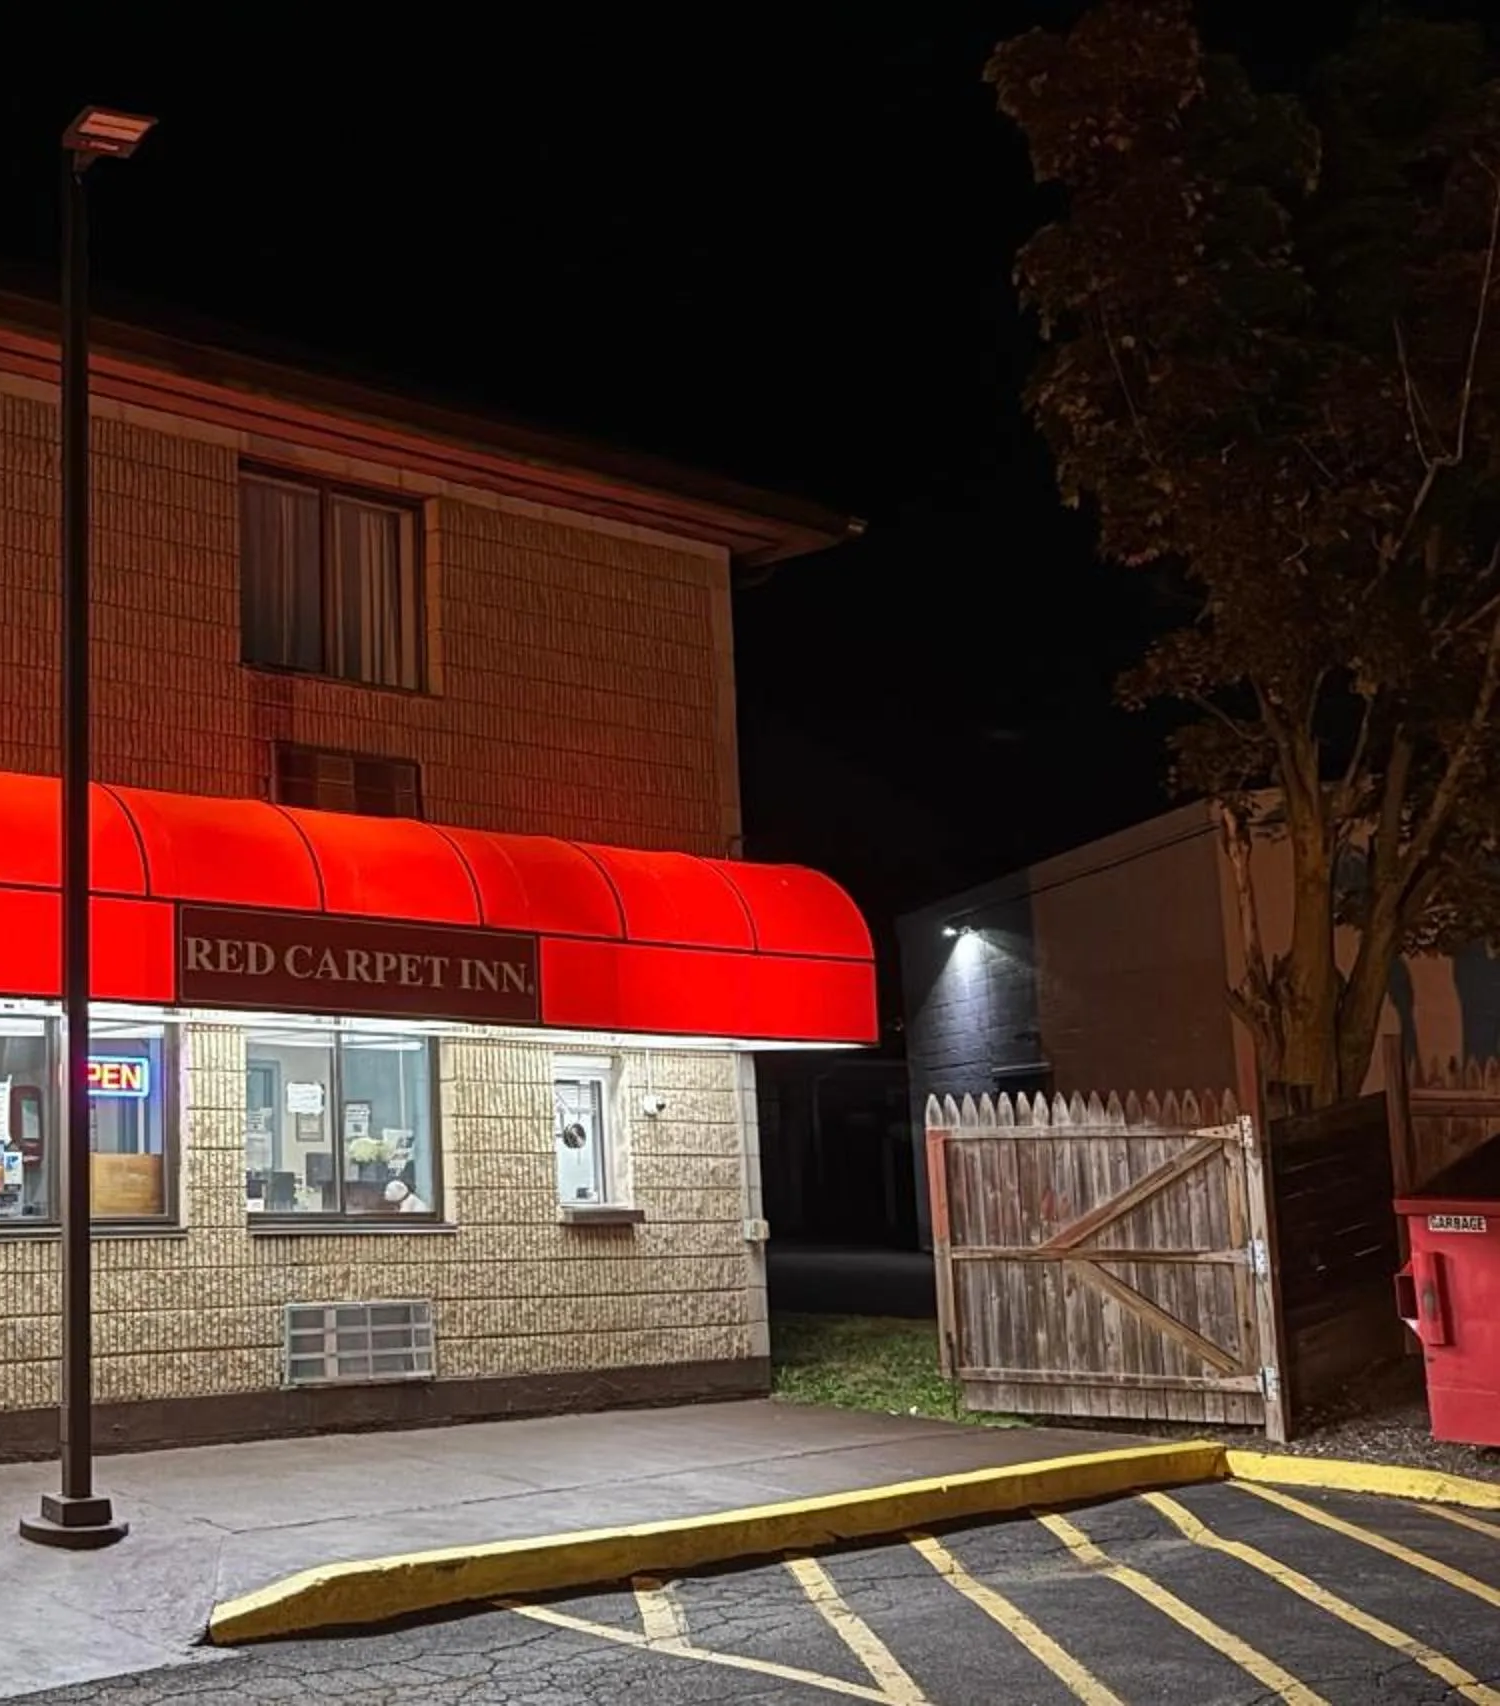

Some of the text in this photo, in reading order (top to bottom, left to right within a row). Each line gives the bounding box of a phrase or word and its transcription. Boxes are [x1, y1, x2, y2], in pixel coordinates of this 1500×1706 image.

[185, 937, 275, 975] RED
[283, 945, 449, 988] CARPET
[87, 1063, 141, 1089] PEN
[1431, 1216, 1484, 1230] GARBAGE
